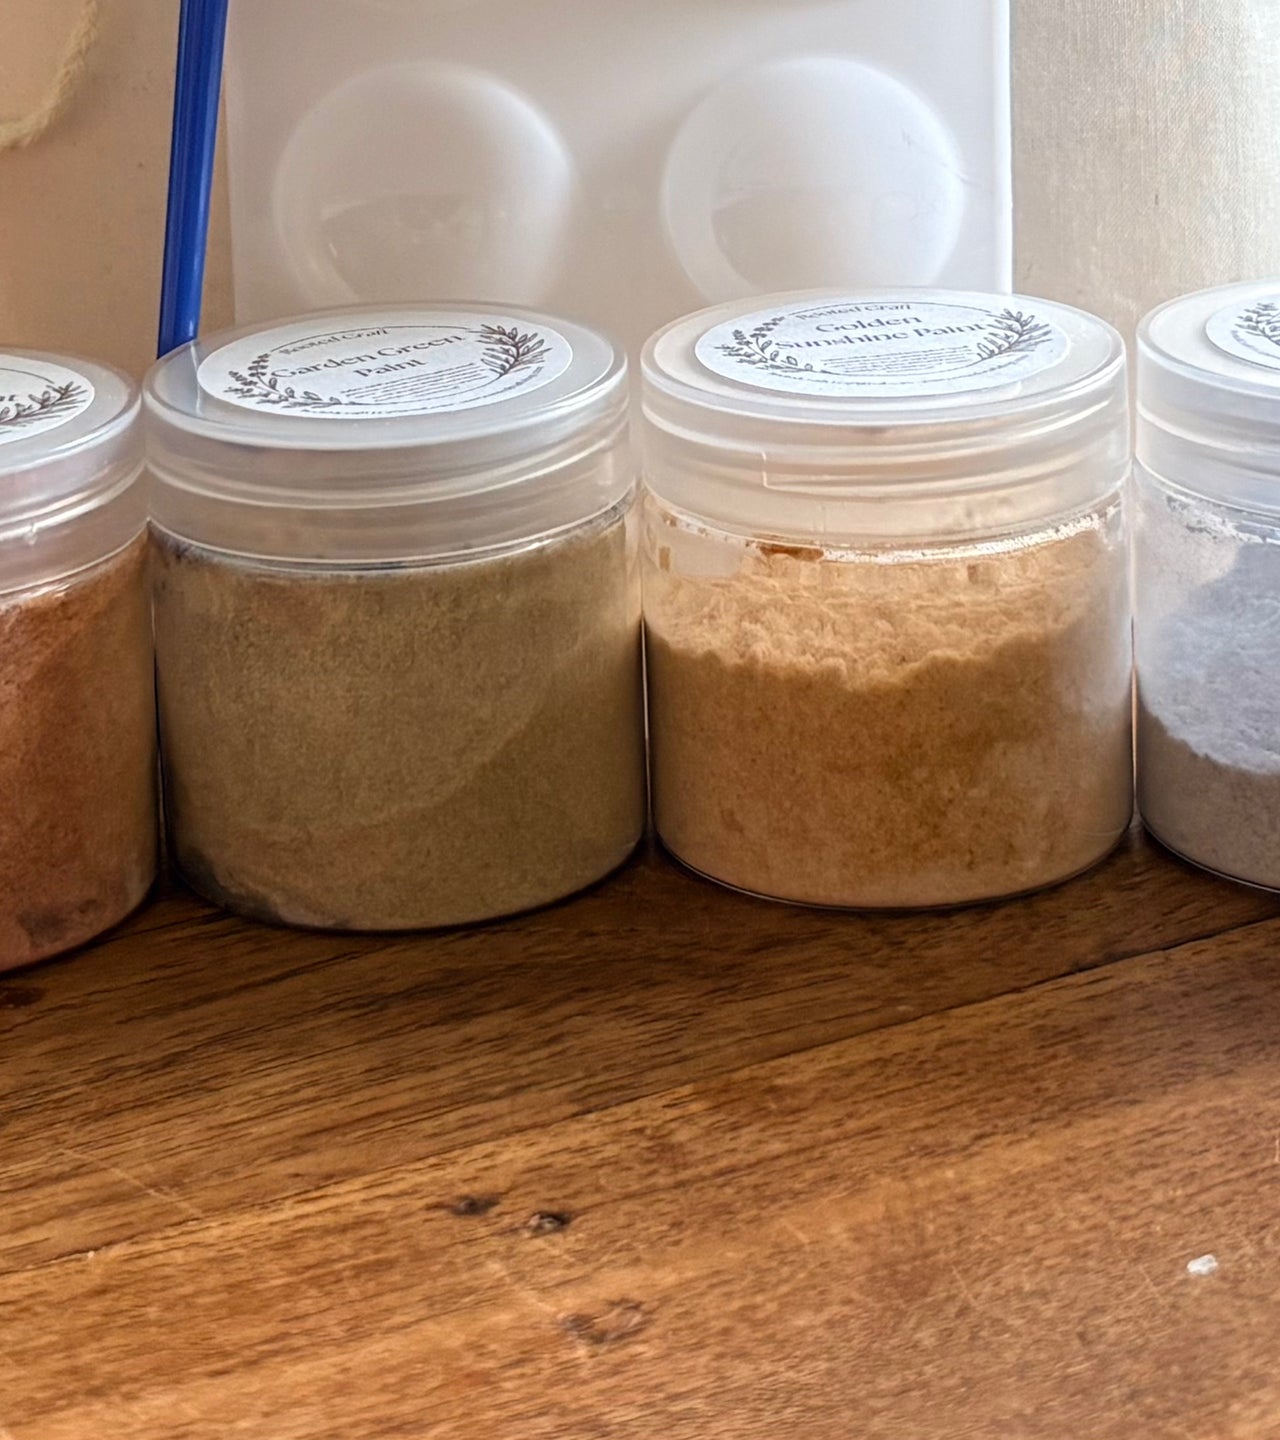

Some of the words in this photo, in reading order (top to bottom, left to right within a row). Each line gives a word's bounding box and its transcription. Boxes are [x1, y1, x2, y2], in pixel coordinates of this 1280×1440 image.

[816, 317, 923, 332] Golden
[775, 332, 910, 350] Sunshine
[913, 323, 988, 337] Paint
[271, 355, 377, 378] Garden
[377, 335, 466, 356] Green
[353, 359, 427, 378] Paint
